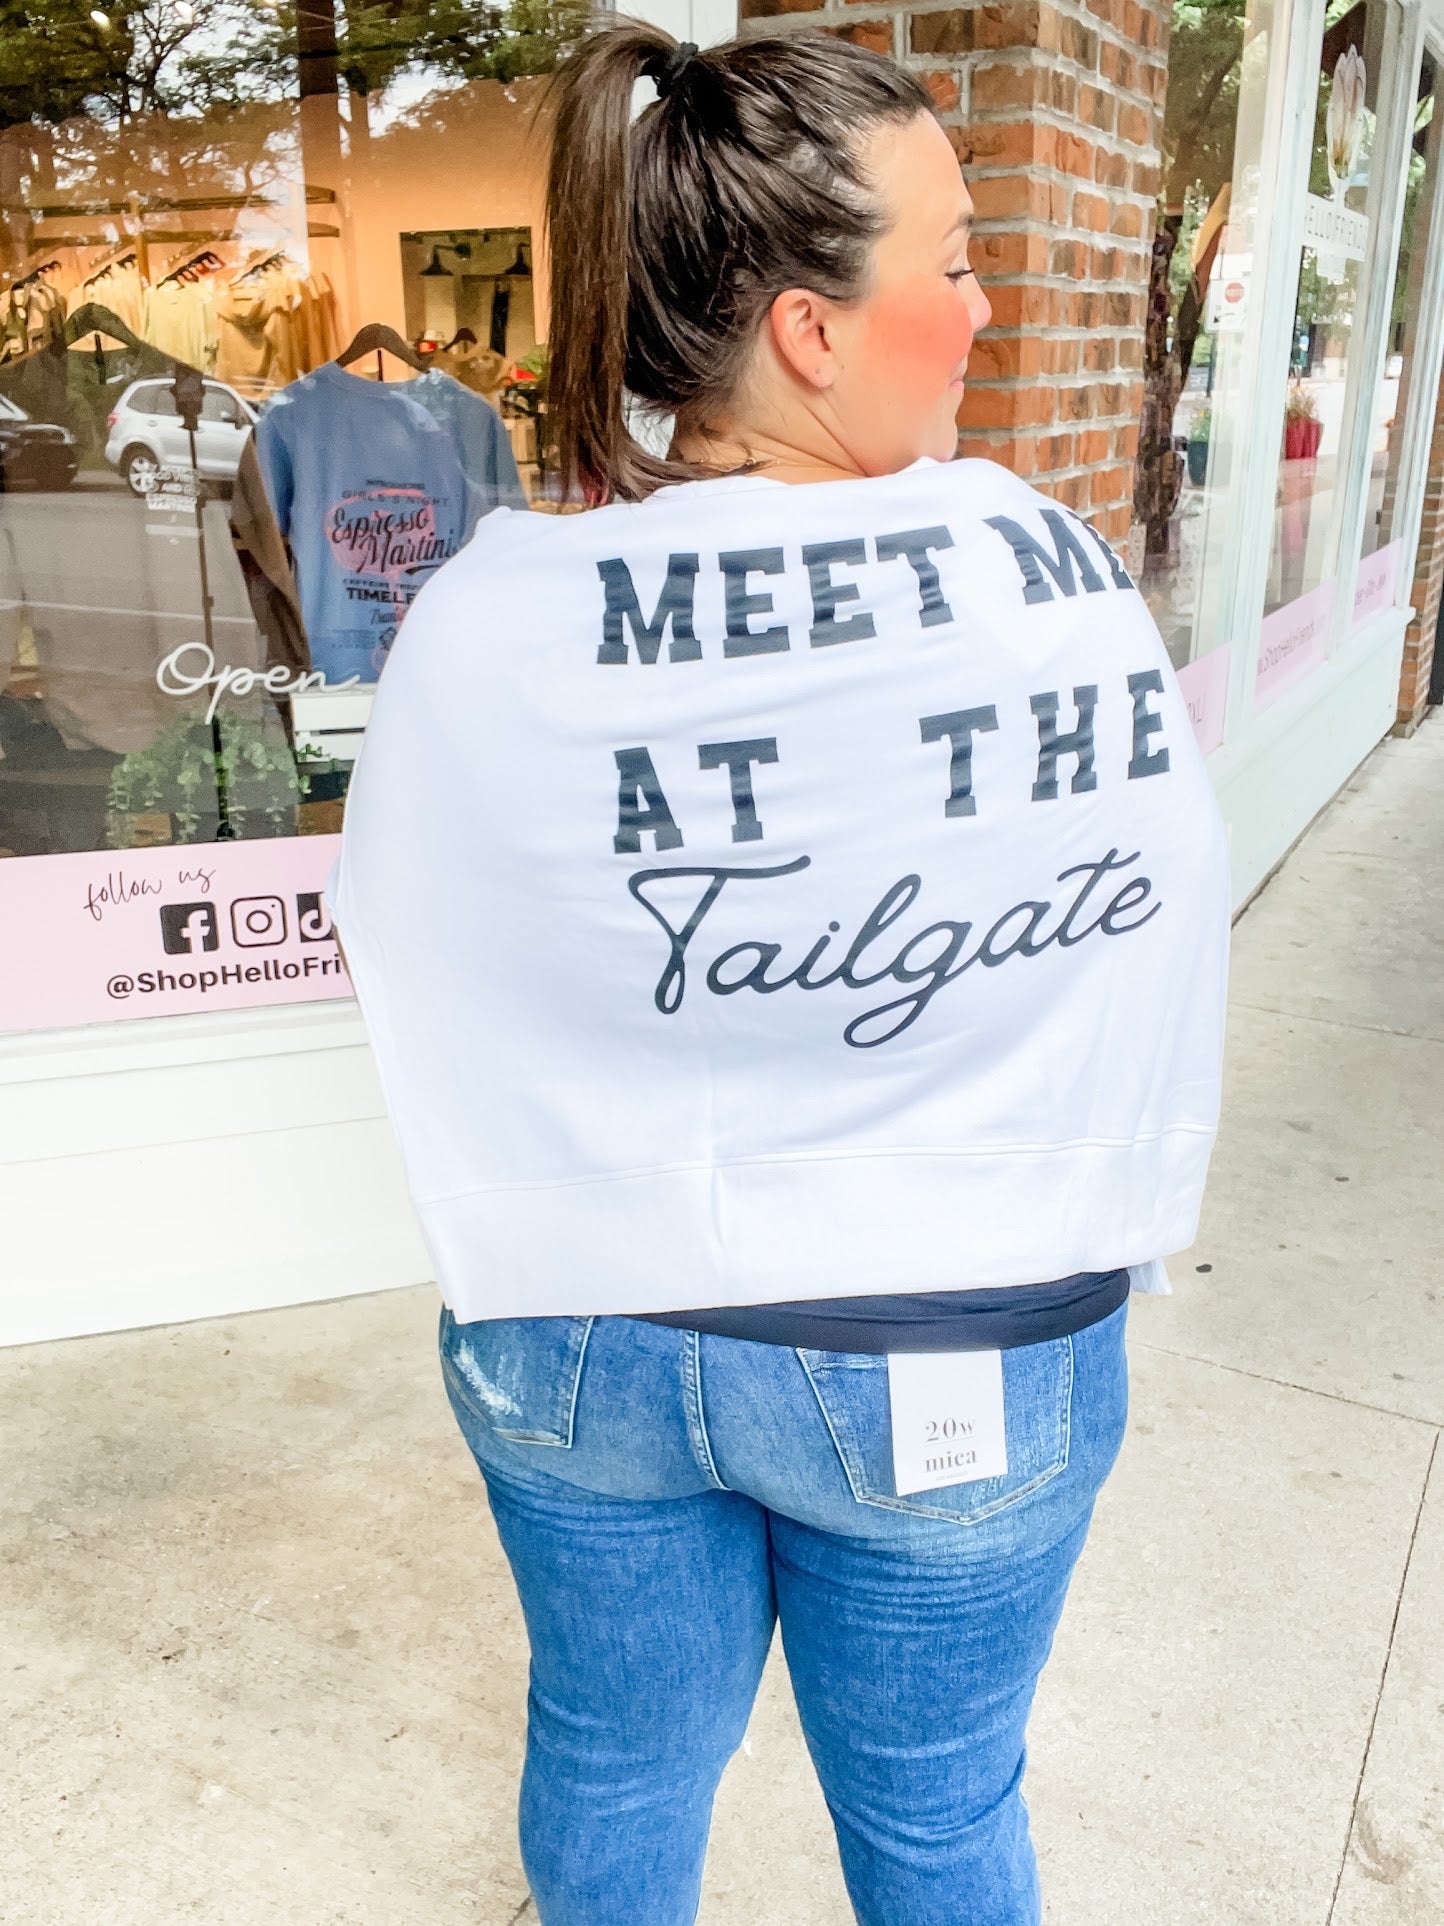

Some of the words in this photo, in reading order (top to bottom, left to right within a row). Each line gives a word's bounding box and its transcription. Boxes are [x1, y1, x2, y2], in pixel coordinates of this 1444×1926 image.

[331, 507, 430, 550] Espresso
[346, 587, 416, 604] TIMELE
[596, 525, 957, 665] MEET
[157, 641, 361, 726] Open
[613, 737, 780, 854] AT
[919, 669, 1171, 819] THE
[83, 871, 162, 921] follow
[178, 867, 217, 893] us
[627, 848, 1163, 1049] Tailgate
[106, 954, 342, 1000] @ShopHelloFri
[923, 1450, 978, 1473] mica
